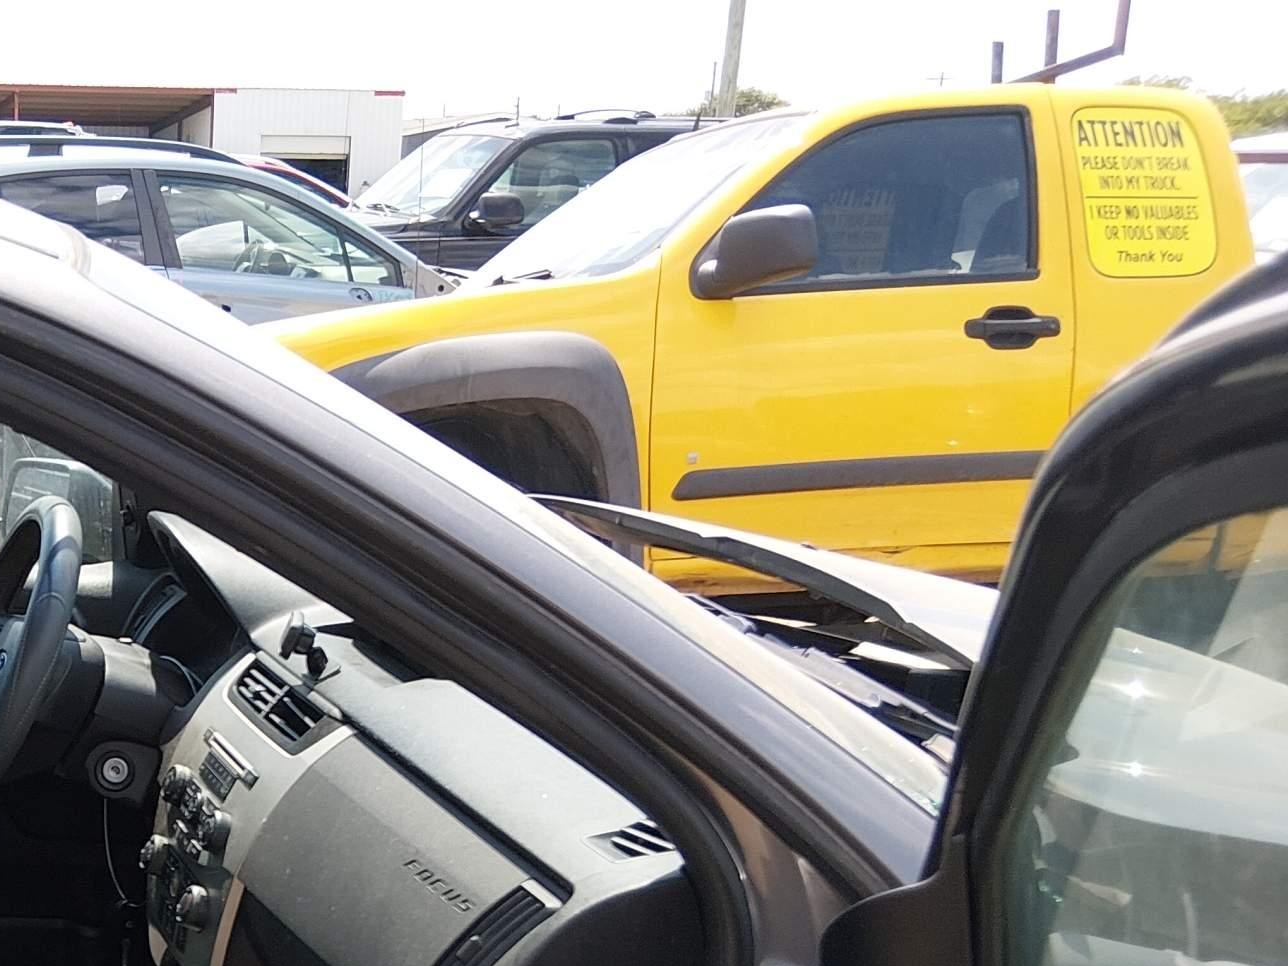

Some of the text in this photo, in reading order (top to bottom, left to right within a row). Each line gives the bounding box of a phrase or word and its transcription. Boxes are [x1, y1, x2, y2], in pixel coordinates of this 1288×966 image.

[1077, 119, 1185, 148] ATTENTION
[1081, 155, 1190, 171] PLEASE DON'T BREAK
[1099, 175, 1123, 190] INTO
[1126, 176, 1141, 190] MY
[1097, 205, 1121, 220] KEEP
[1125, 205, 1140, 220] NO
[1143, 206, 1199, 220] VALUABLES
[1105, 225, 1189, 240] OR TOOLS INSIDE
[1117, 250, 1183, 262] Thank You
[403, 860, 475, 913] FOCUS
